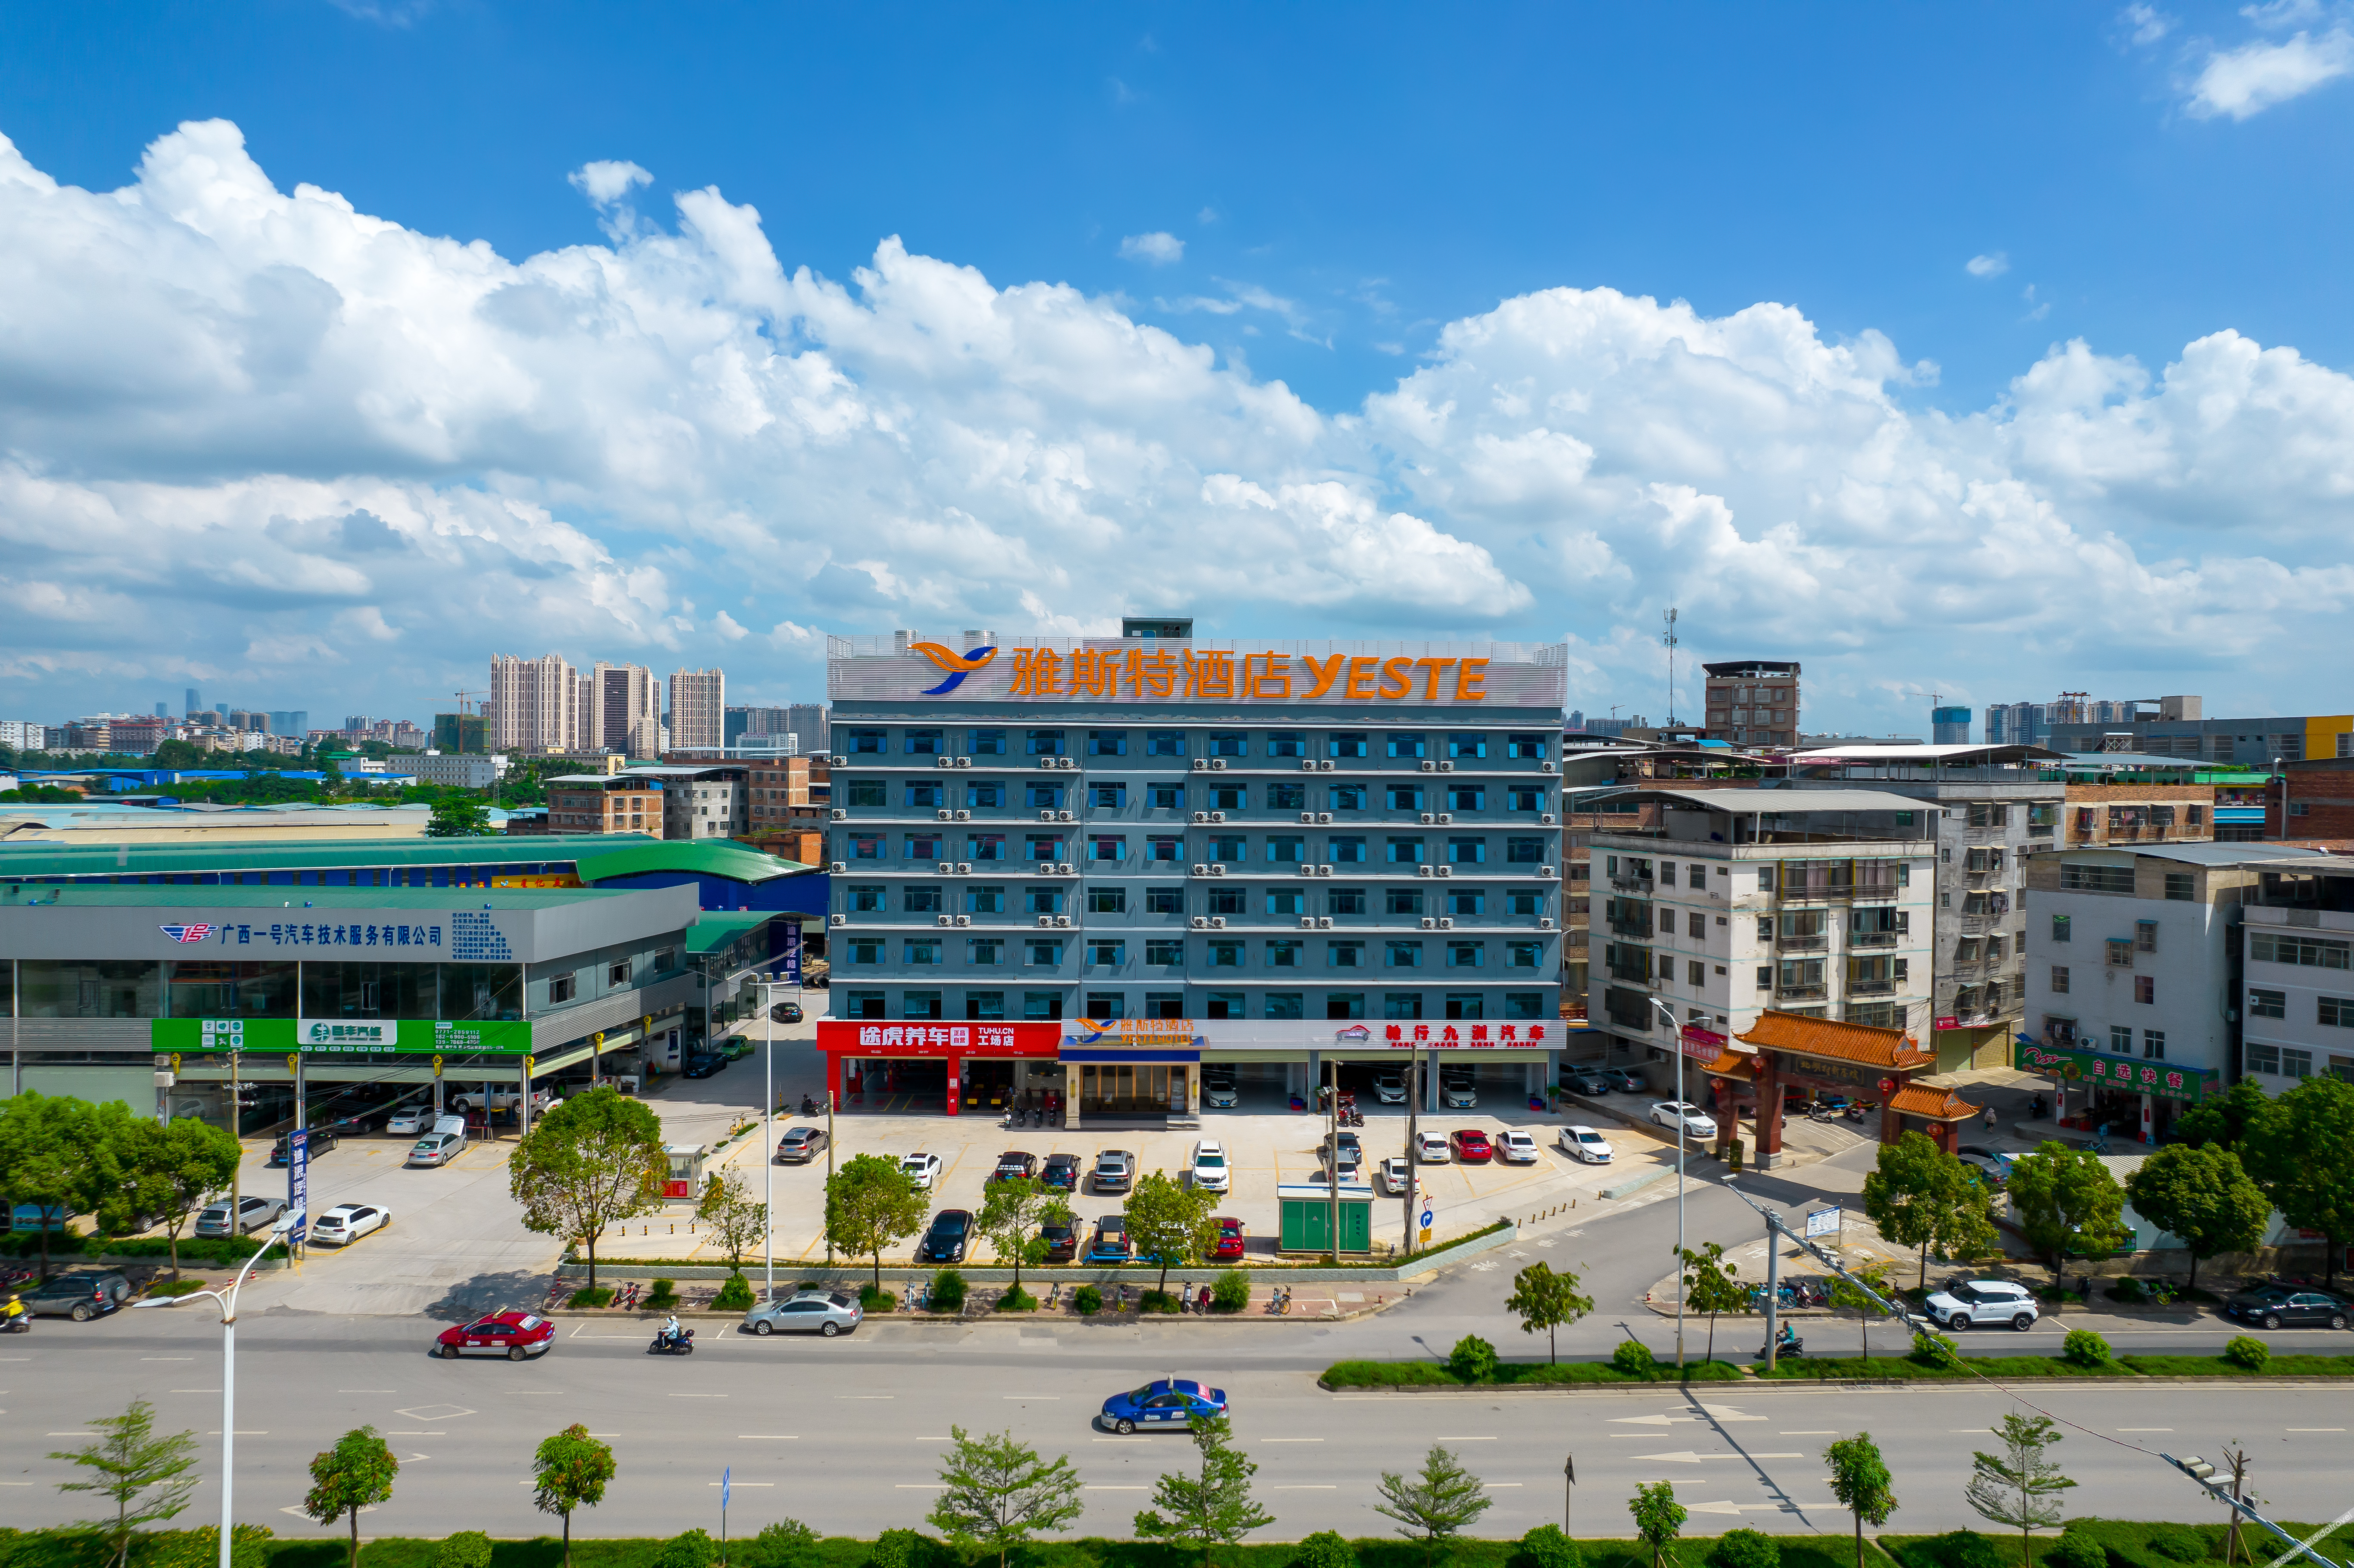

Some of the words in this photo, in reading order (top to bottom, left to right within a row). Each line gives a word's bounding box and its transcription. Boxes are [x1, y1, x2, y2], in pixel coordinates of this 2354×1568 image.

[1009, 647, 1290, 697] 雅斯特酒店
[1301, 653, 1490, 699] YESTE
[221, 923, 442, 946] 广西一号汽车技术服务有限公司
[1120, 1019, 1194, 1031] 雅斯特酒店
[1386, 1025, 1544, 1040] 驰行九洲汽车
[860, 1027, 949, 1046] 途虎养车
[978, 1036, 1014, 1046] 工场店
[2093, 1060, 2183, 1089] 自选快餐
[293, 1148, 304, 1227] 迪浪汽修
